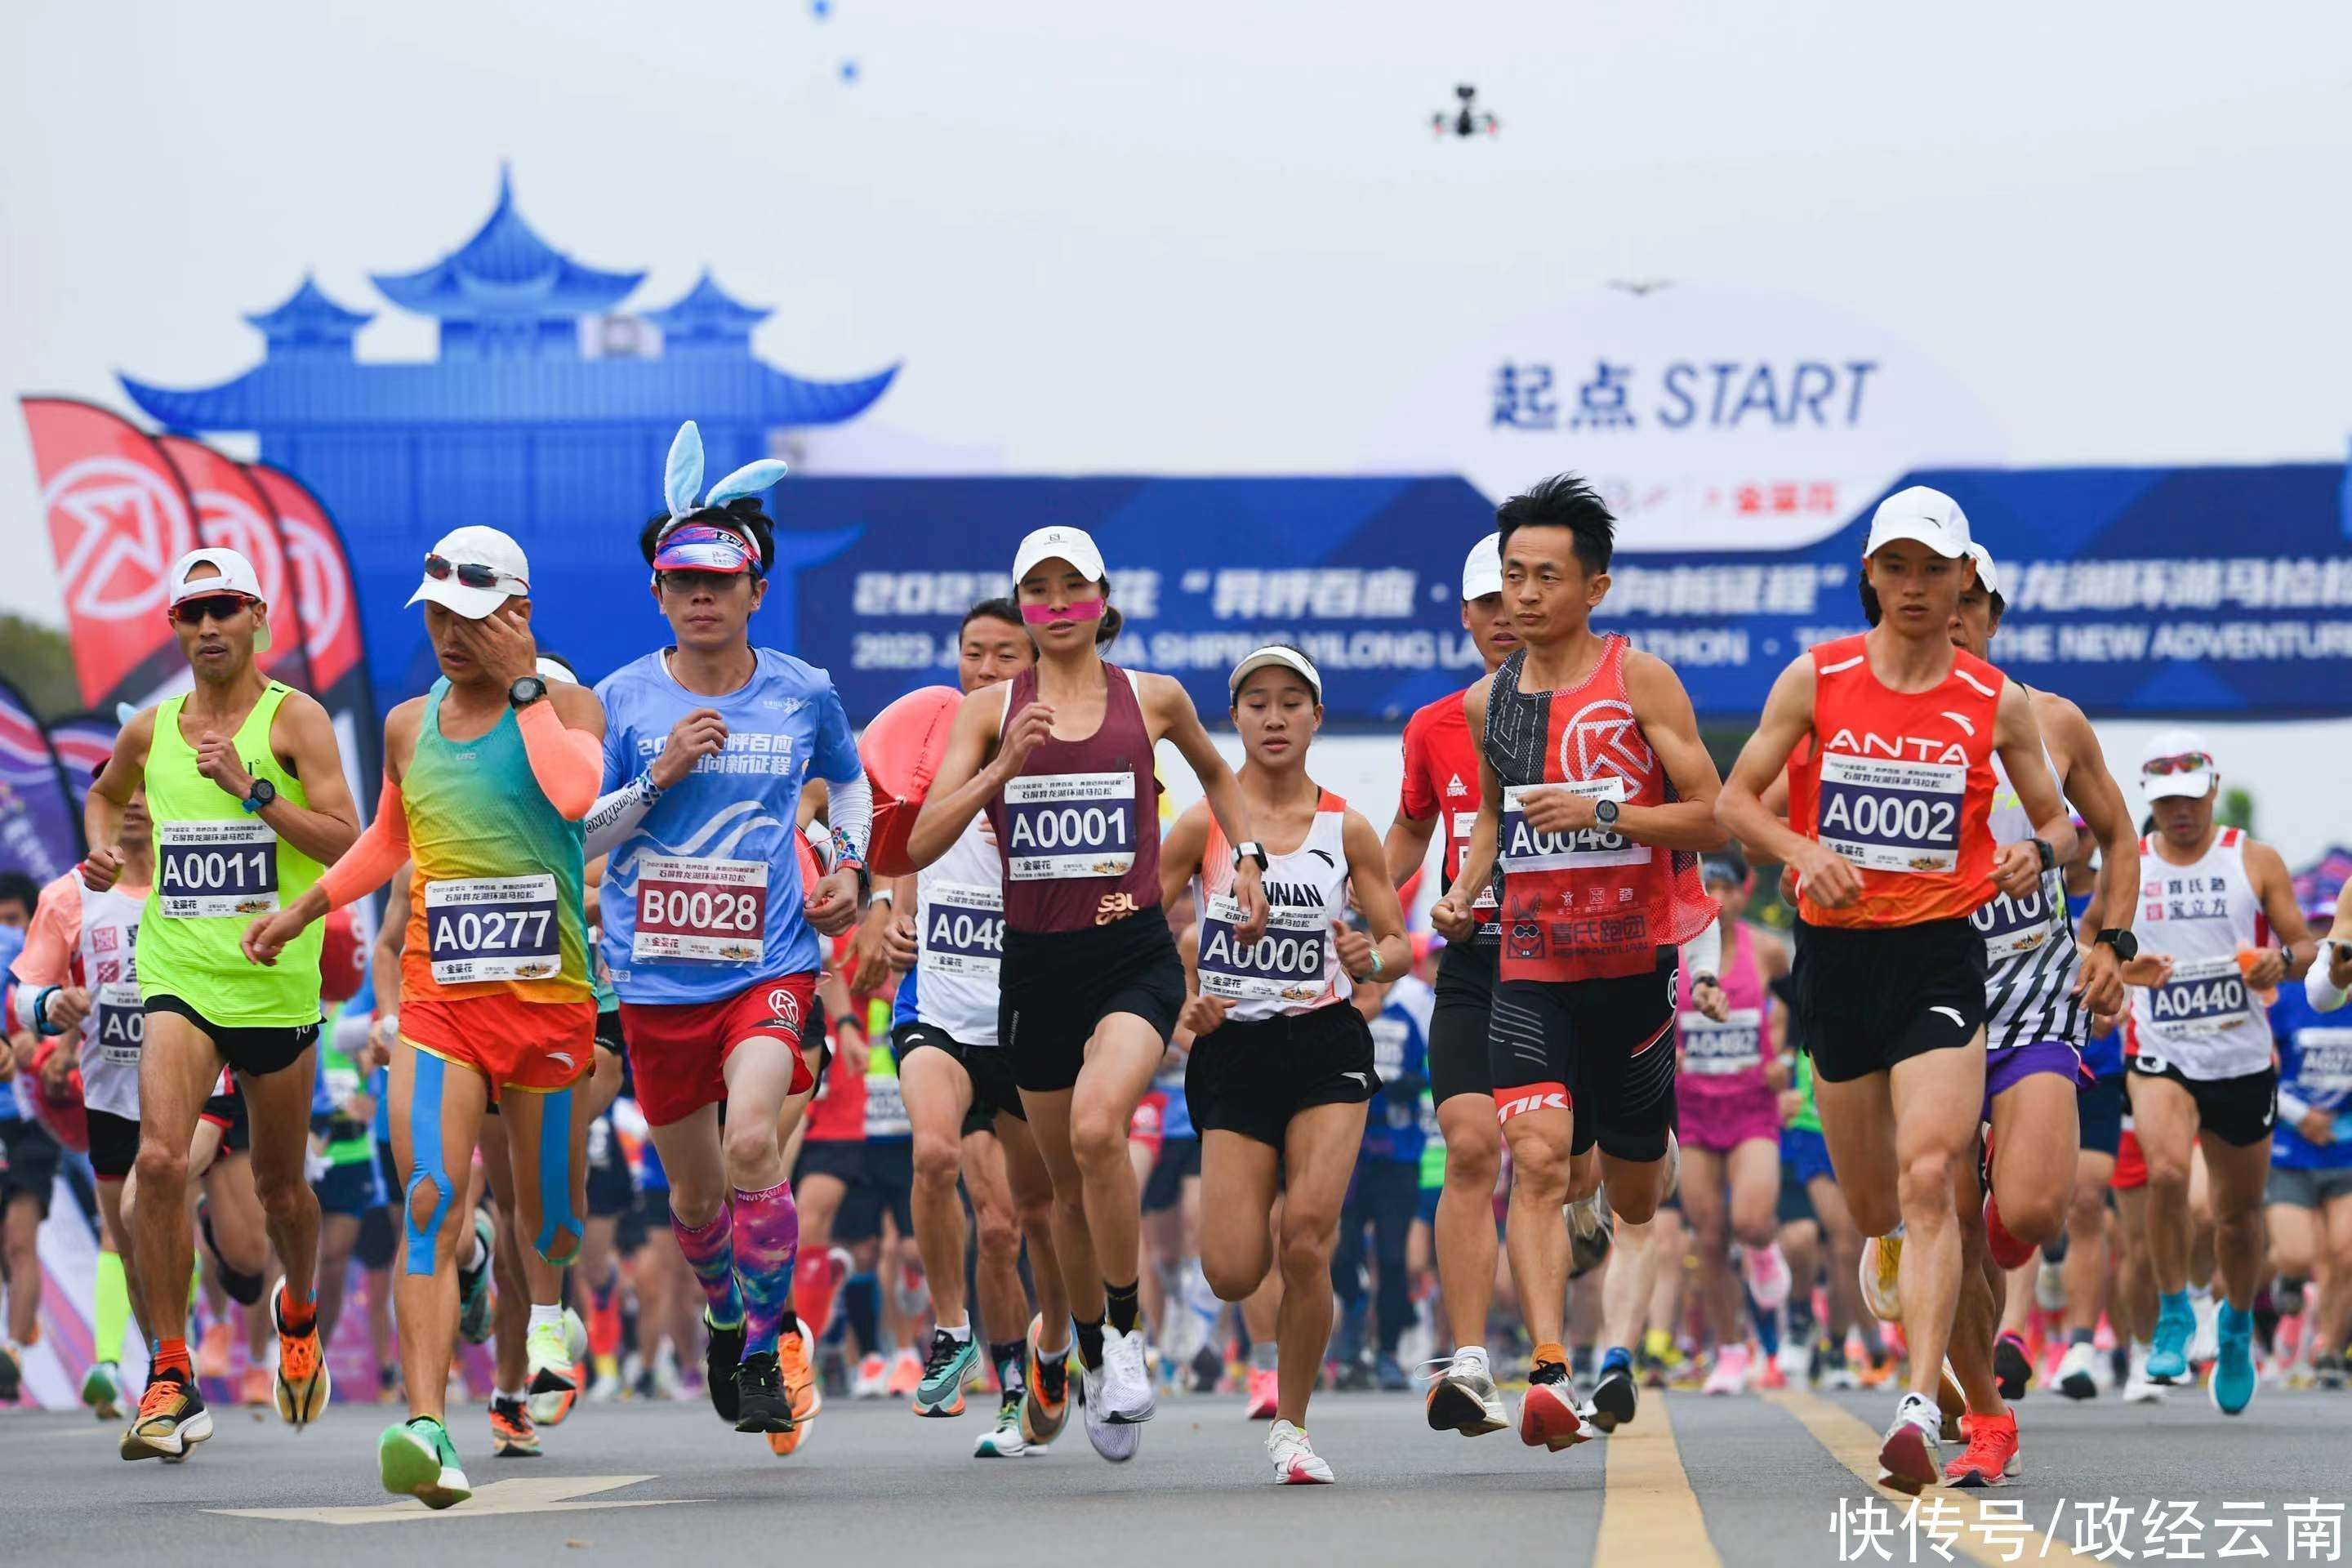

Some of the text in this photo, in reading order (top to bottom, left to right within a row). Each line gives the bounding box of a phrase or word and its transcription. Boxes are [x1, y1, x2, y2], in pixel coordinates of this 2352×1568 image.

[1490, 362, 1878, 430] 起点 START
[1829, 728, 1970, 768] ANTA
[1011, 808, 1126, 849] A0001
[1823, 793, 1955, 841] A0002
[163, 852, 267, 889] A0011
[643, 889, 758, 932] B0028
[1230, 880, 1325, 907] NNAN
[1969, 891, 2041, 931] 010
[434, 910, 551, 951] A0277
[1203, 929, 1321, 973] A0006
[2154, 981, 2243, 1017] A0440
